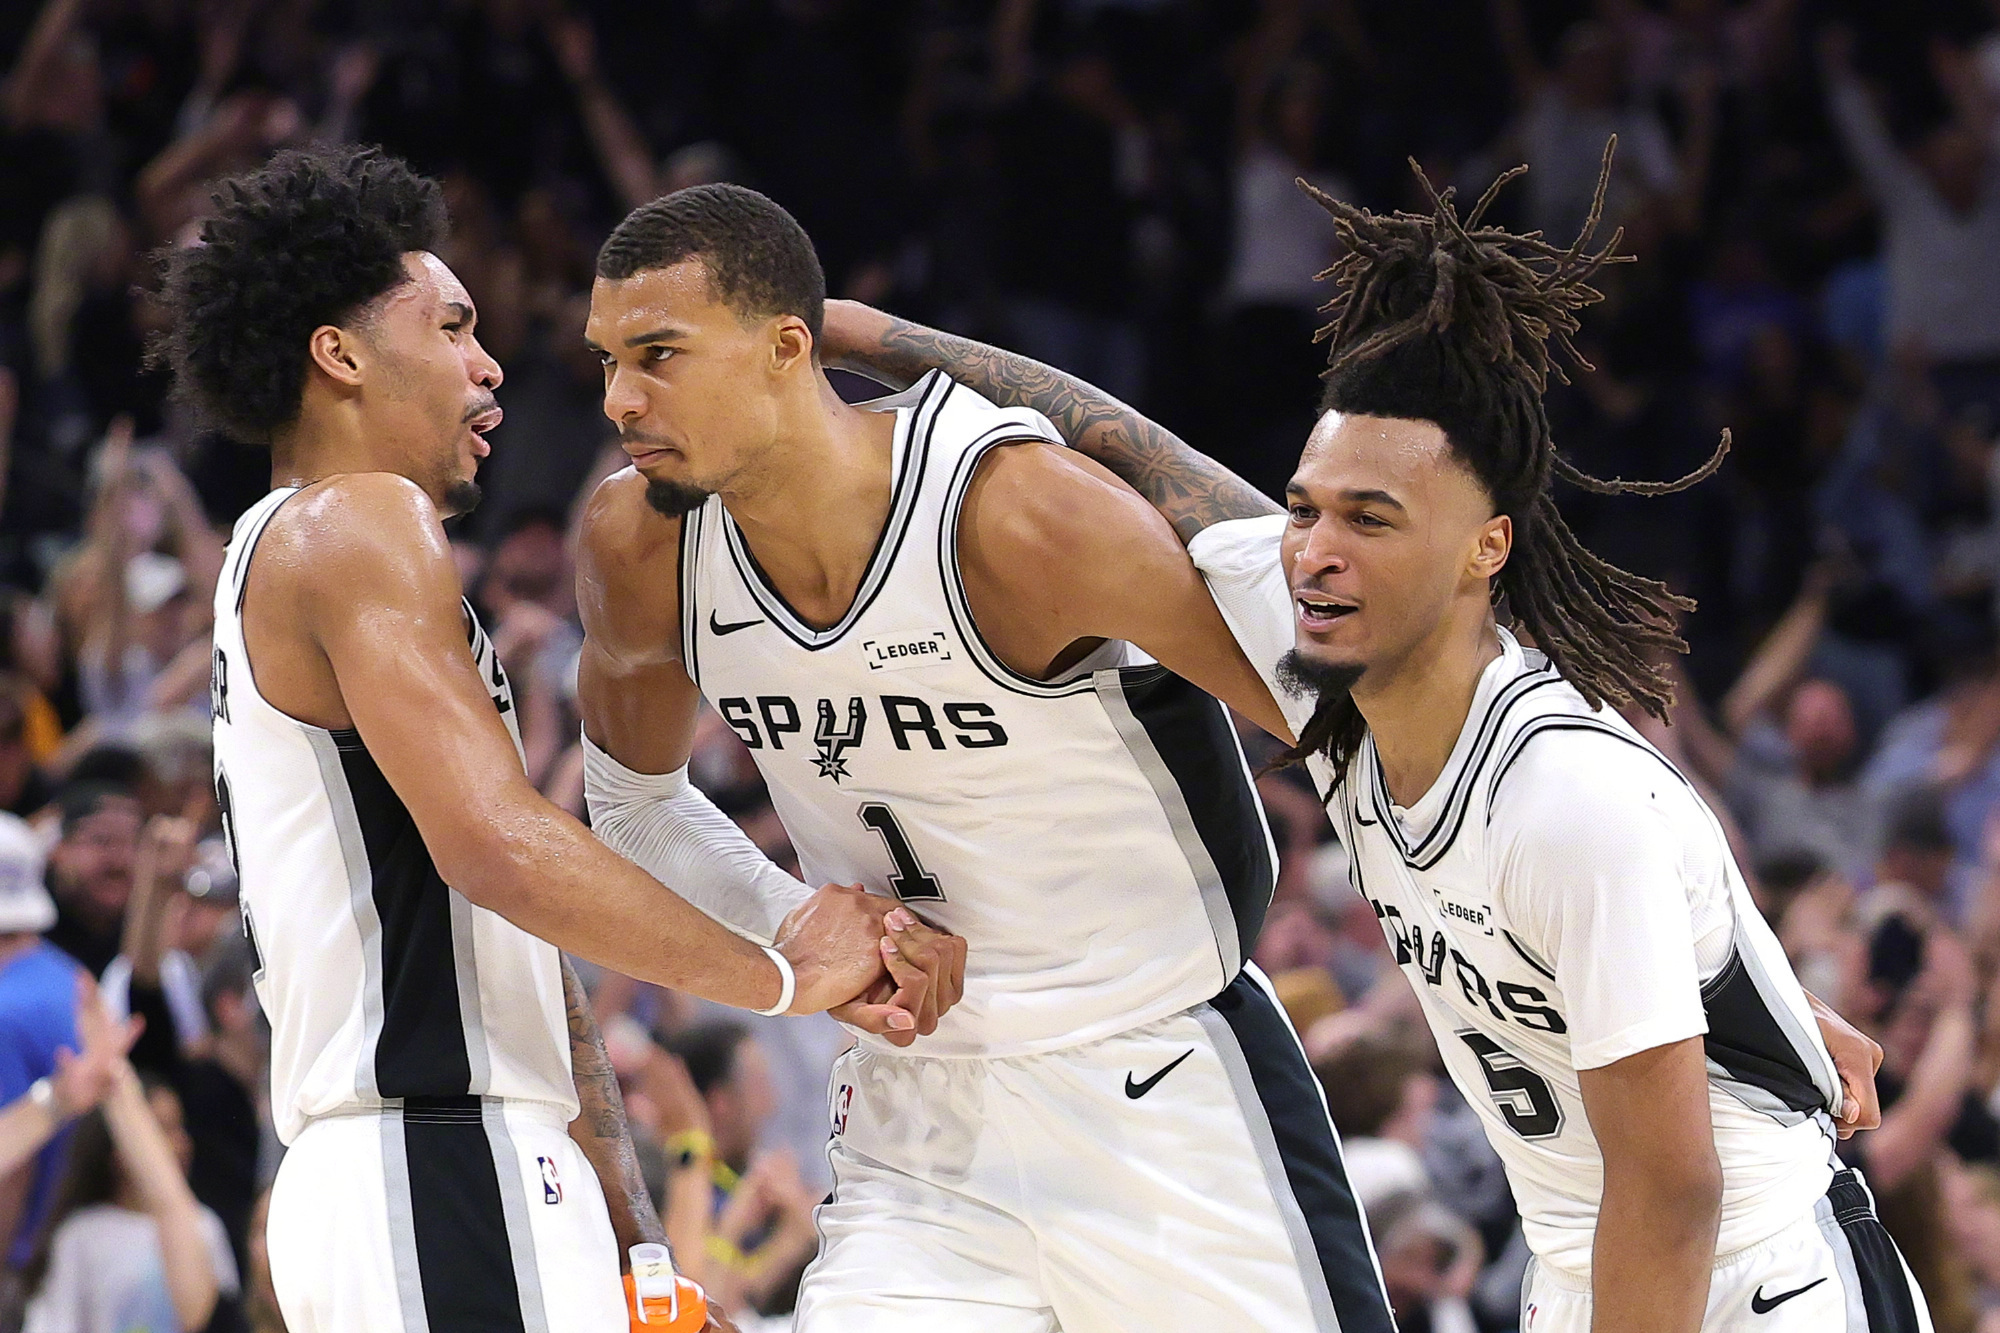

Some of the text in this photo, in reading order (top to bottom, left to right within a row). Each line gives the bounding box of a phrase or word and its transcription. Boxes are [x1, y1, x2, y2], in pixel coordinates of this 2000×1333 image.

[876, 641, 939, 660] LEDGER
[719, 694, 1009, 785] SPURS
[857, 801, 947, 902] 1
[1440, 899, 1484, 926] LEDGER
[1453, 1027, 1567, 1142] 5
